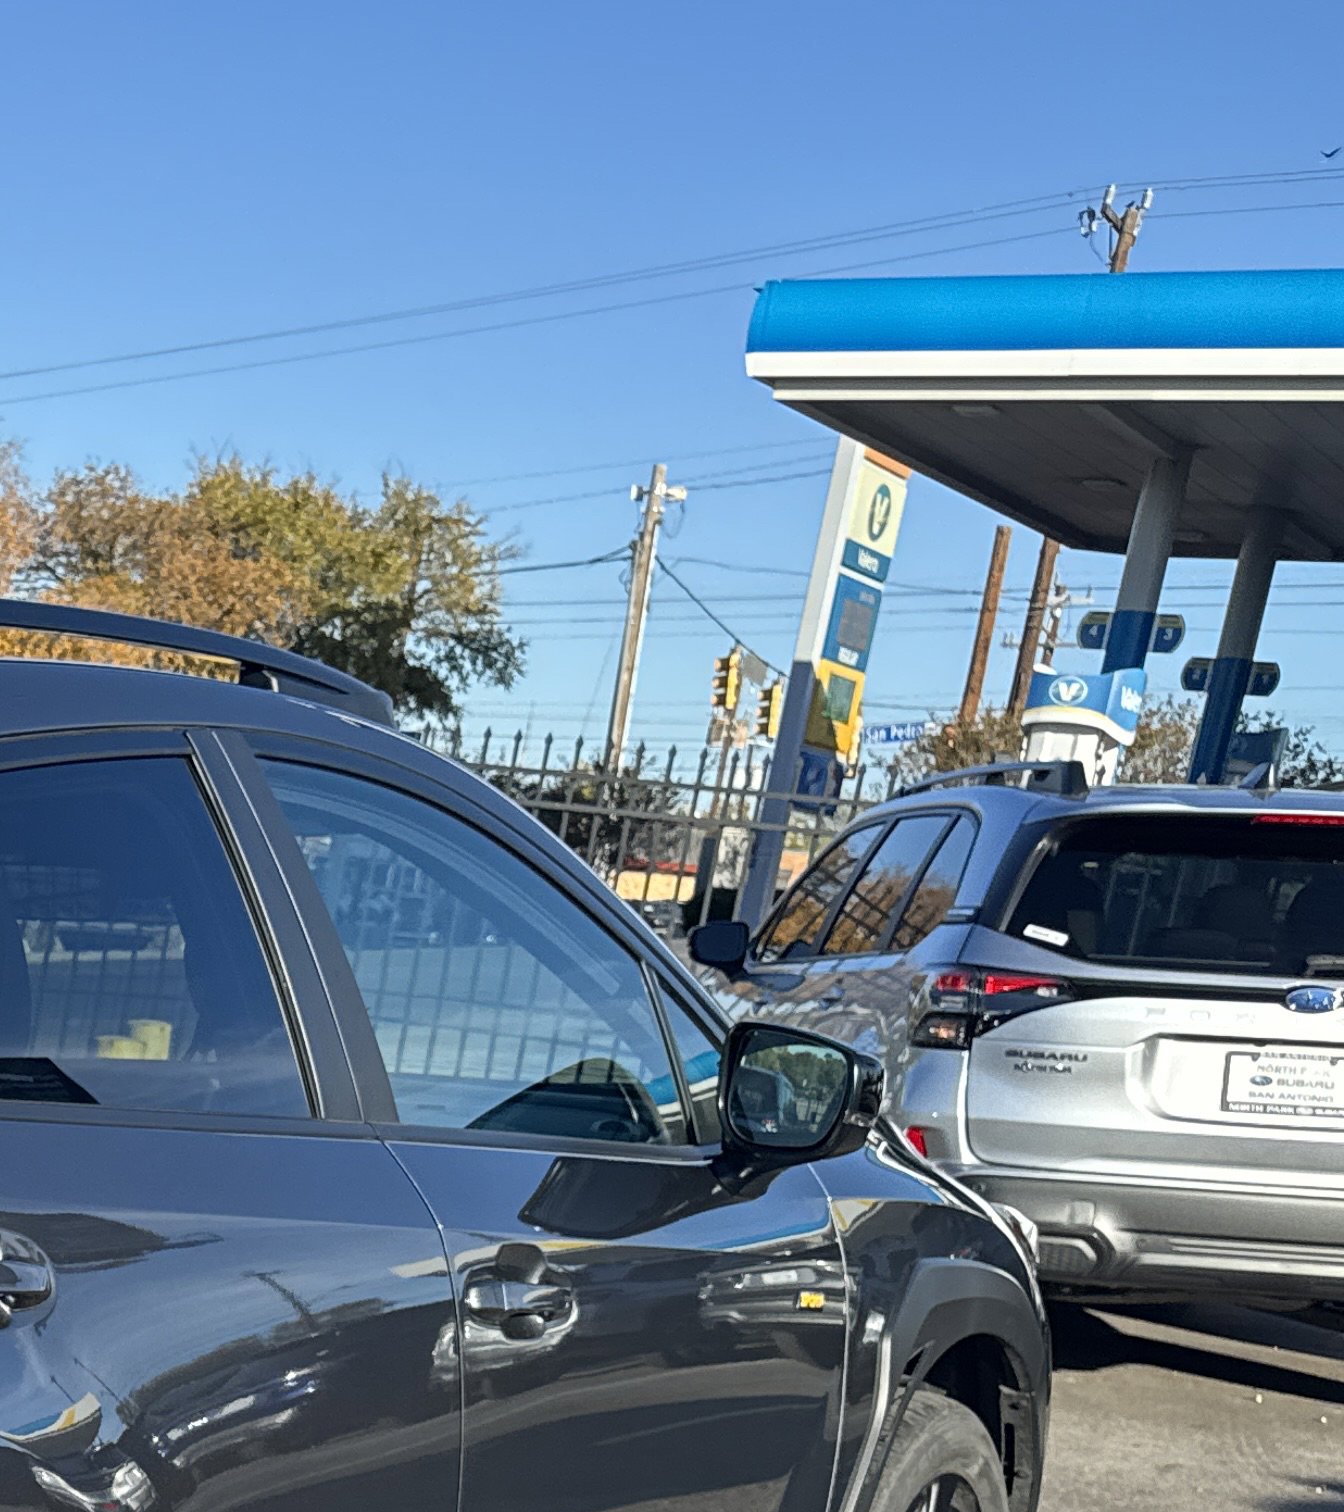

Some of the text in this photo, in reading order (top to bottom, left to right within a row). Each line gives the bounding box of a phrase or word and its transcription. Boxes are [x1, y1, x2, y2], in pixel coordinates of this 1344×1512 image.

[865, 726, 887, 742] San
[890, 723, 924, 740] Pedro
[1004, 1049, 1089, 1062] SUBARU
